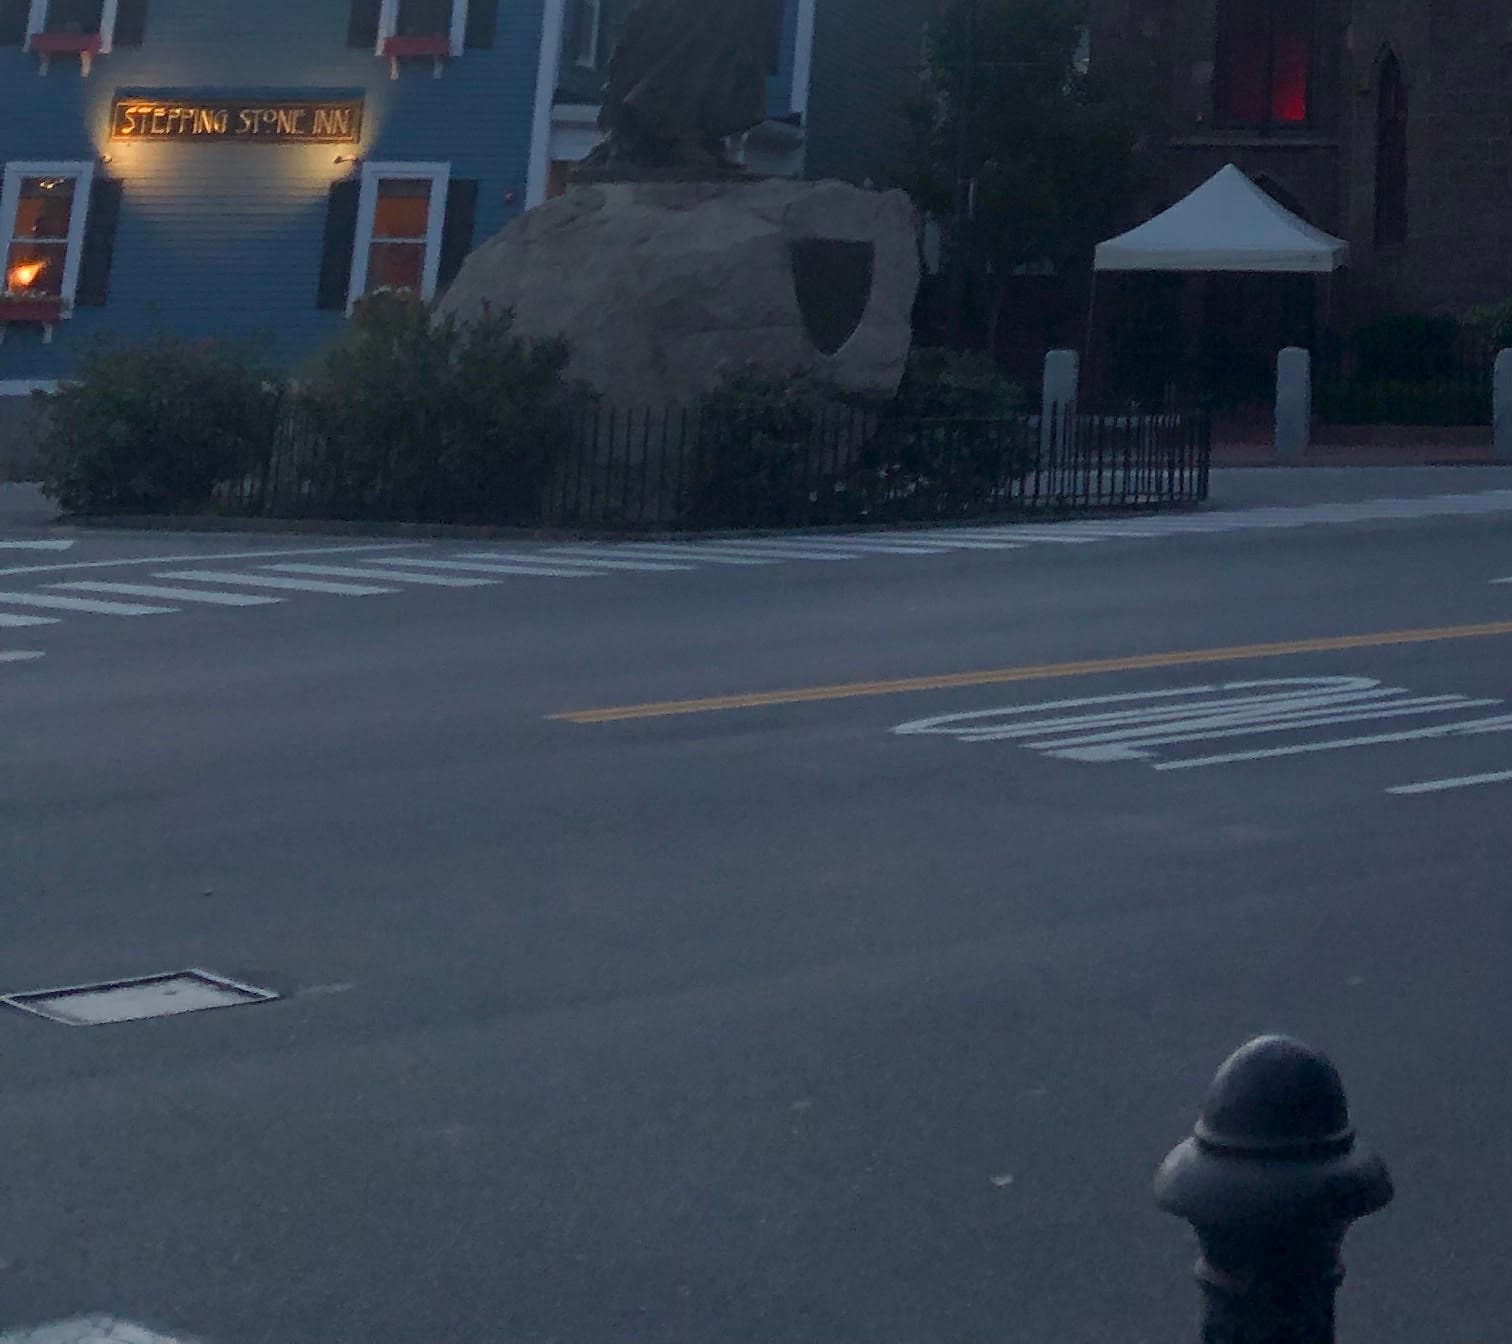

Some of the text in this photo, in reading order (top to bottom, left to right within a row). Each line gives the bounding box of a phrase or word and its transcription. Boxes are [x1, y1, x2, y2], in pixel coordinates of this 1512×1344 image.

[120, 105, 351, 135] STEPPING STONE INN
